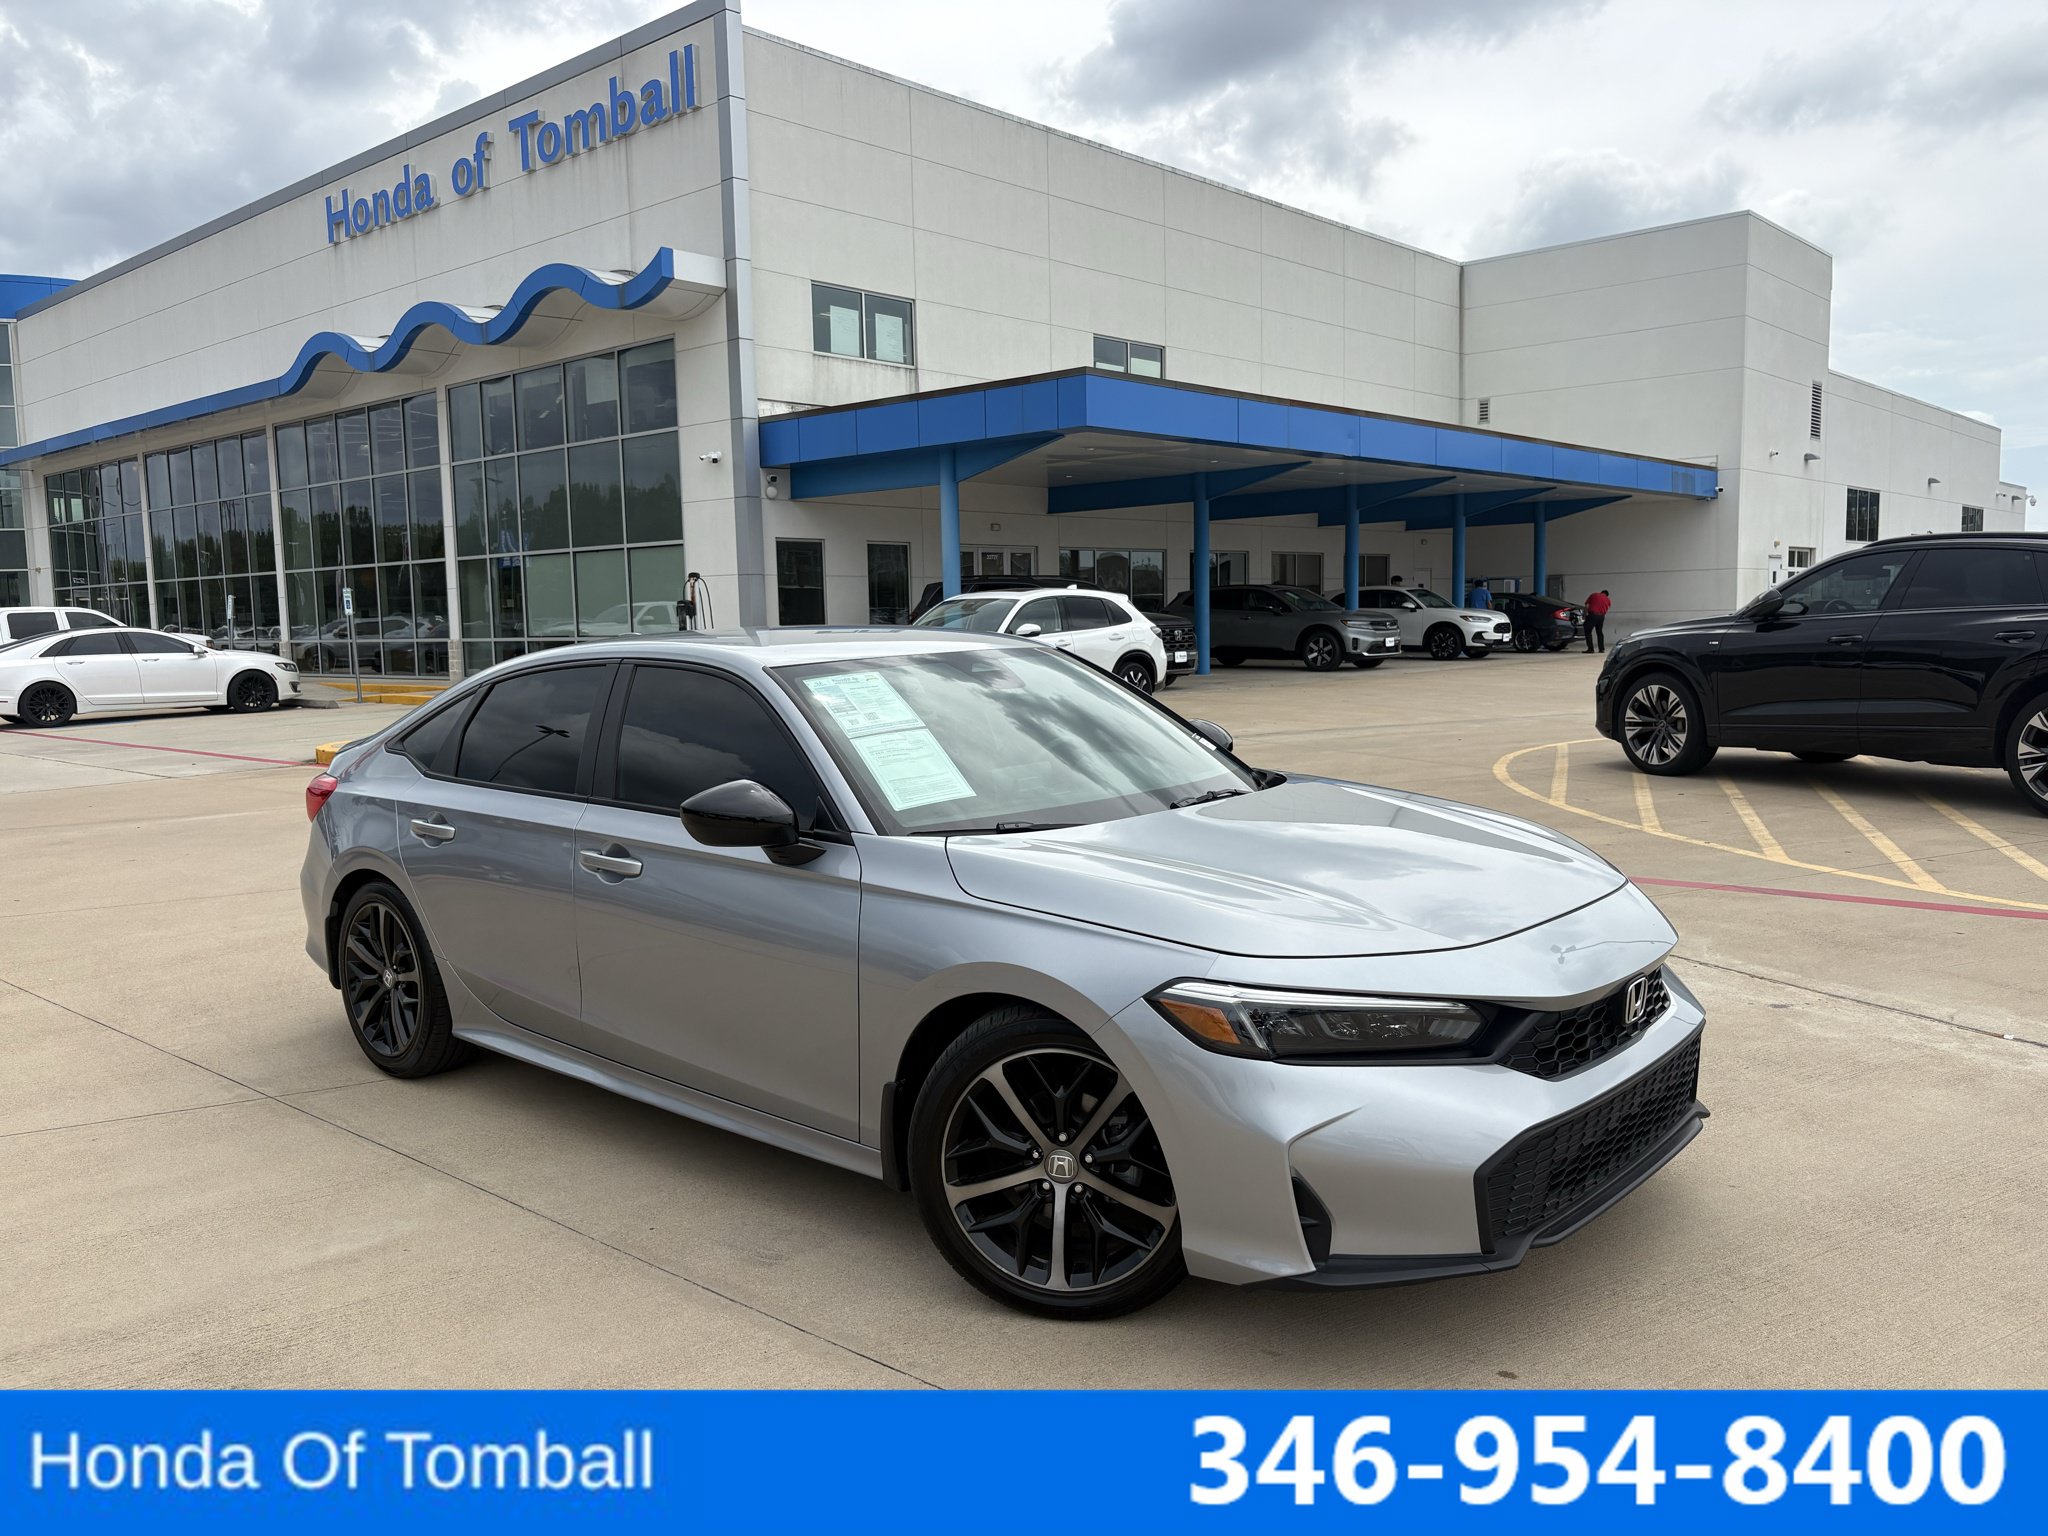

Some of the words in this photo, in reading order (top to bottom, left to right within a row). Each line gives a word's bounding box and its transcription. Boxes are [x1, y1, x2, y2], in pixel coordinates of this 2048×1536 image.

[325, 163, 437, 244] Honda
[452, 131, 494, 196] of
[508, 44, 699, 173] Tomball
